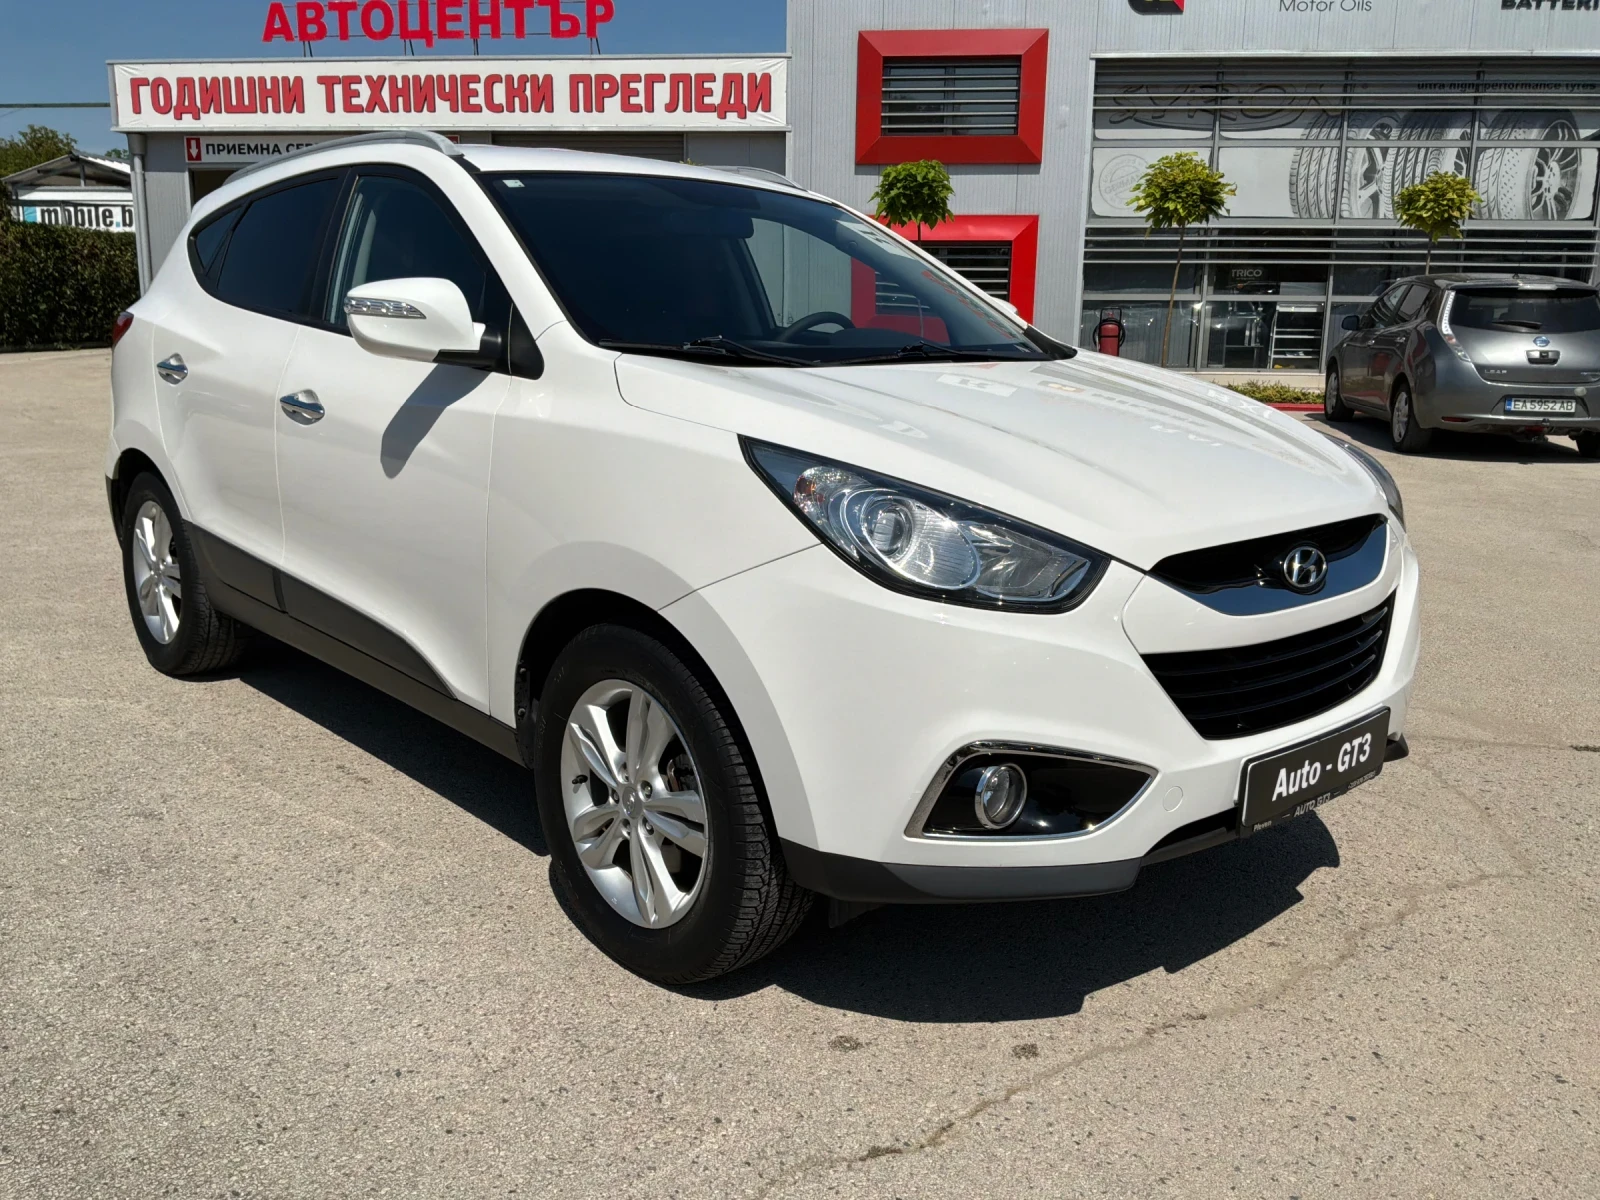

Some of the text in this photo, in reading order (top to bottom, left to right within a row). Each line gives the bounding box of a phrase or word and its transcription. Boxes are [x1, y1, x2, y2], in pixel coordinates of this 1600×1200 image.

[1279, 0, 1372, 12] Motor Oils
[261, 0, 615, 48] АВТОЦЕНТЪР
[130, 72, 772, 120] ГОДИШНИ ТЕХНИЧЕСКИ ПРЕГЛЕДИ
[206, 143, 282, 155] ПРИЕМНА
[1231, 269, 1262, 277] TRICO
[1513, 399, 1574, 411] EA 5952 AB
[1271, 759, 1321, 802] Auto
[1337, 732, 1372, 774] GT3
[1293, 799, 1316, 818] AUTO
